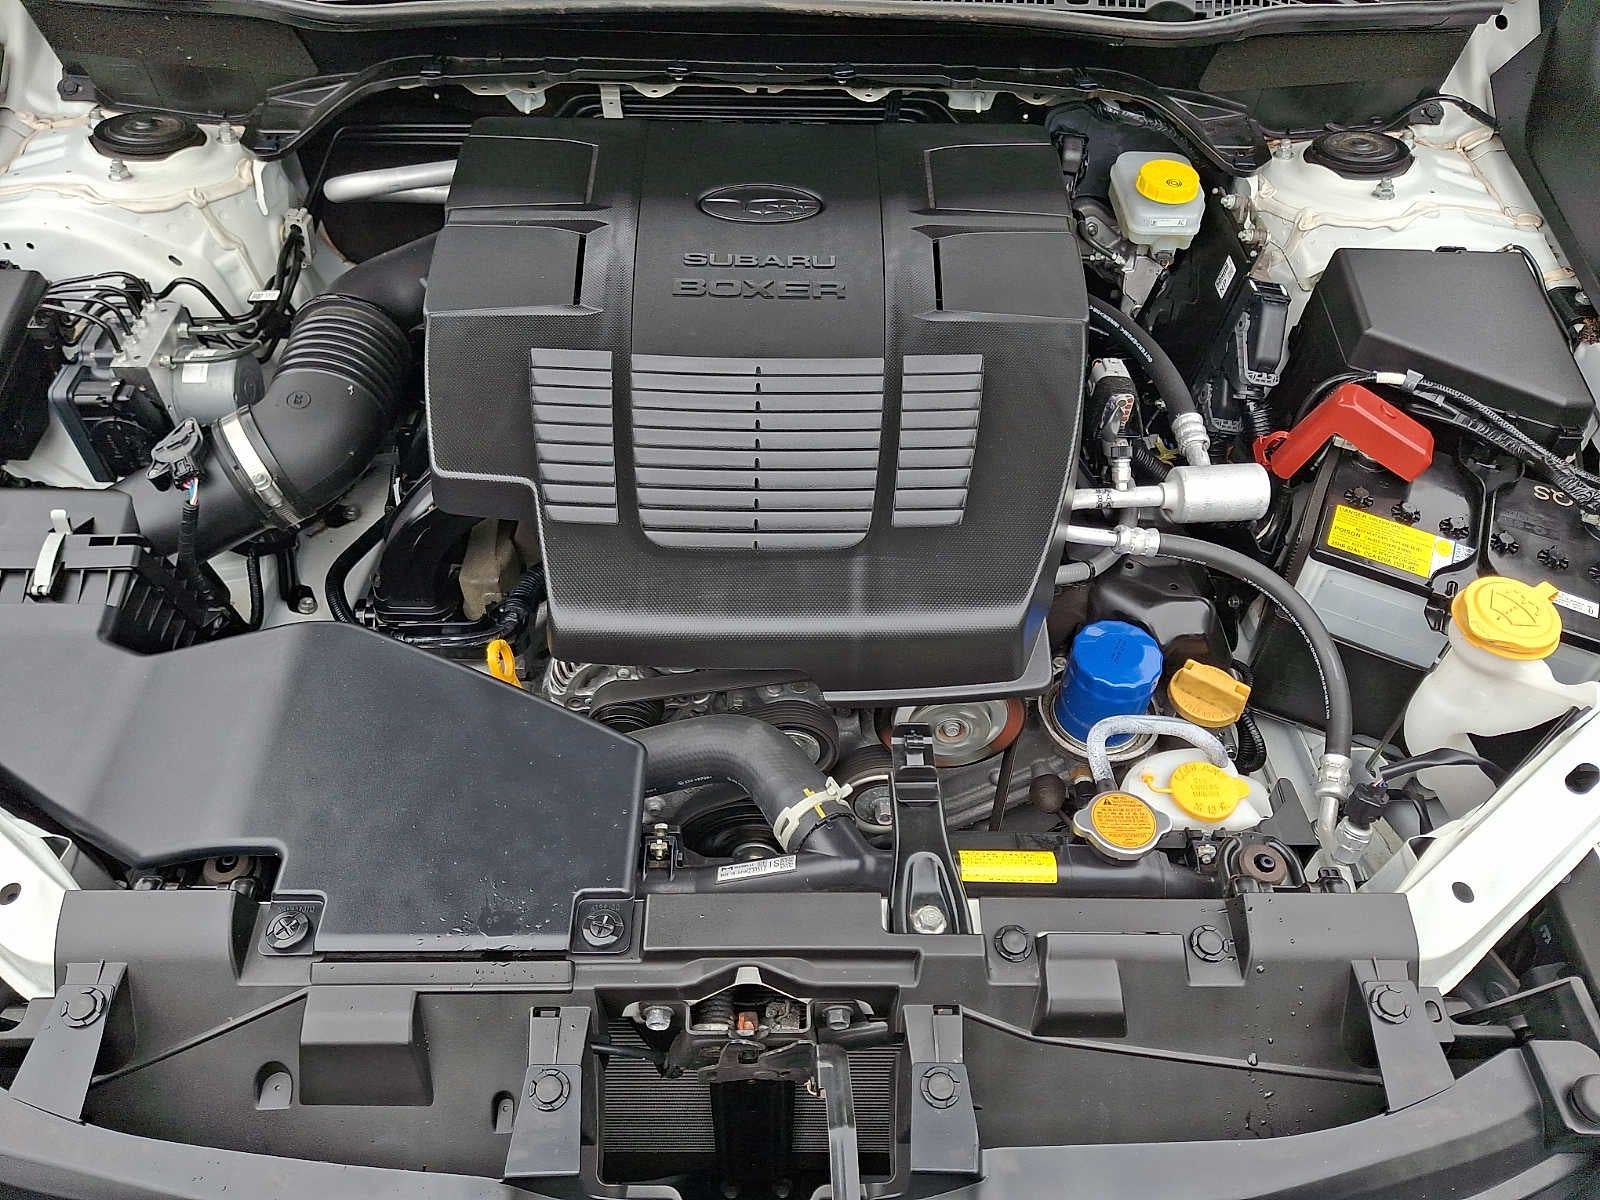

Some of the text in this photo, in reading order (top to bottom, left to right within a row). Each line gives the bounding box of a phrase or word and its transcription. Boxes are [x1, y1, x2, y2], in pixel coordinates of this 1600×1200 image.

[683, 252, 837, 269] SUBARU
[672, 279, 847, 300] BOXER
[1339, 506, 1367, 520] DANGER
[1334, 525, 1361, 538] POISON
